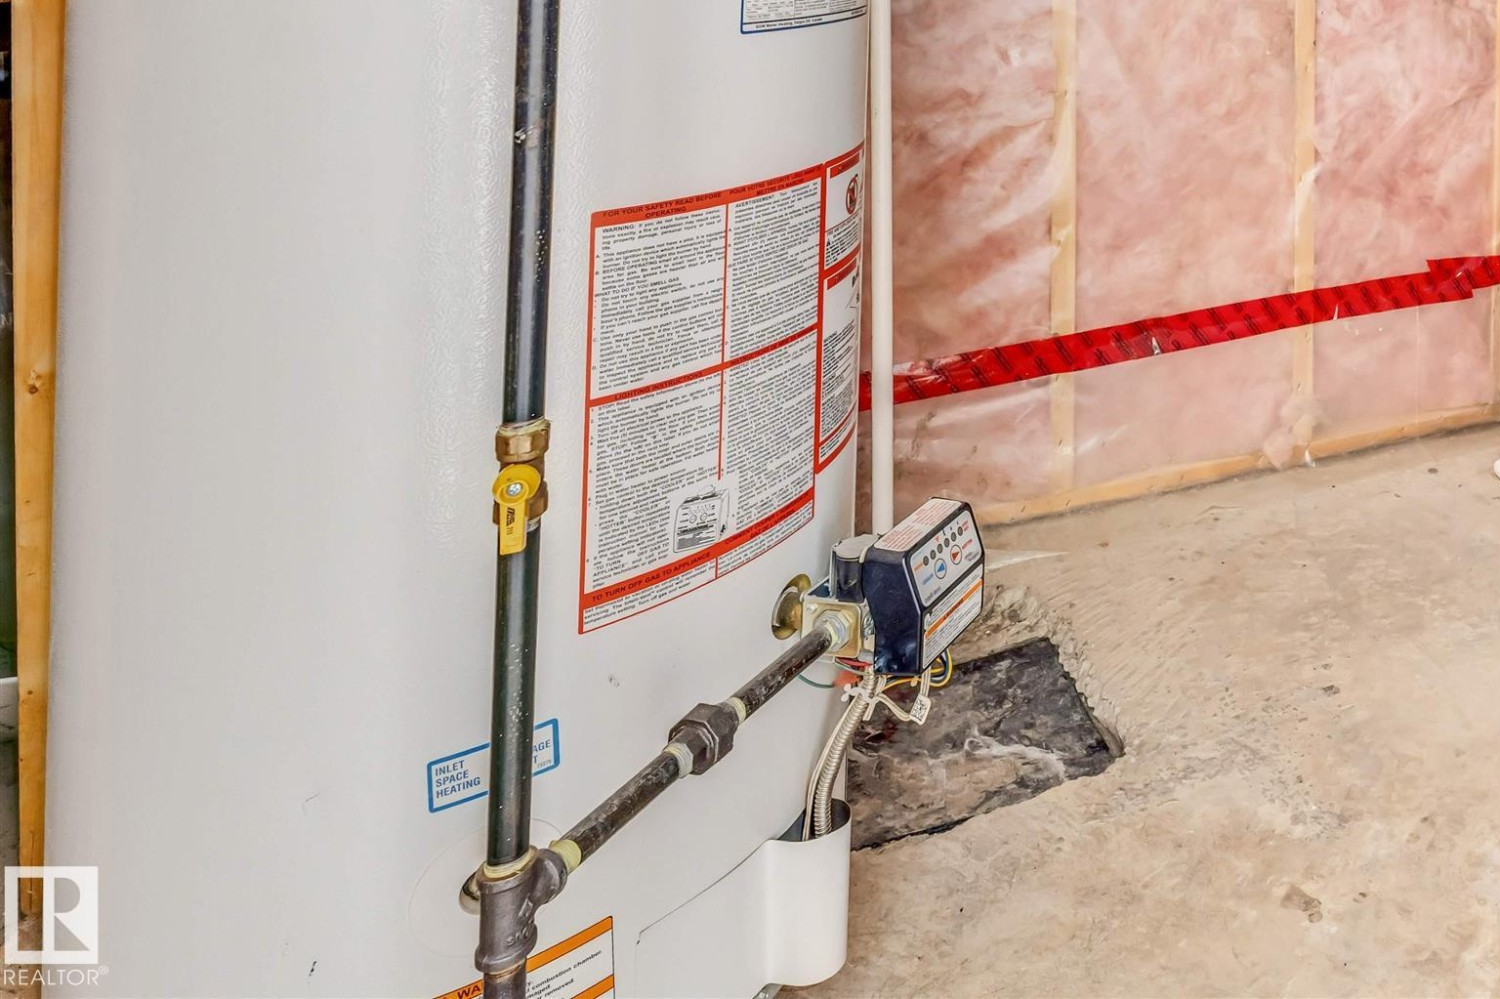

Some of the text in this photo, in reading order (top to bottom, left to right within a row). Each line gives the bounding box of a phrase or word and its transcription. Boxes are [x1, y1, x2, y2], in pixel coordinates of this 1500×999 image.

[622, 207, 644, 215] YOUR
[645, 202, 673, 211] SAFETY
[592, 593, 603, 603] TO
[605, 586, 626, 598] TURN
[627, 579, 643, 591] OFF
[645, 573, 660, 584] GAS
[662, 568, 673, 577] TO
[435, 759, 466, 777] INLET
[435, 769, 469, 788] SPACE
[436, 776, 481, 799] HEATING
